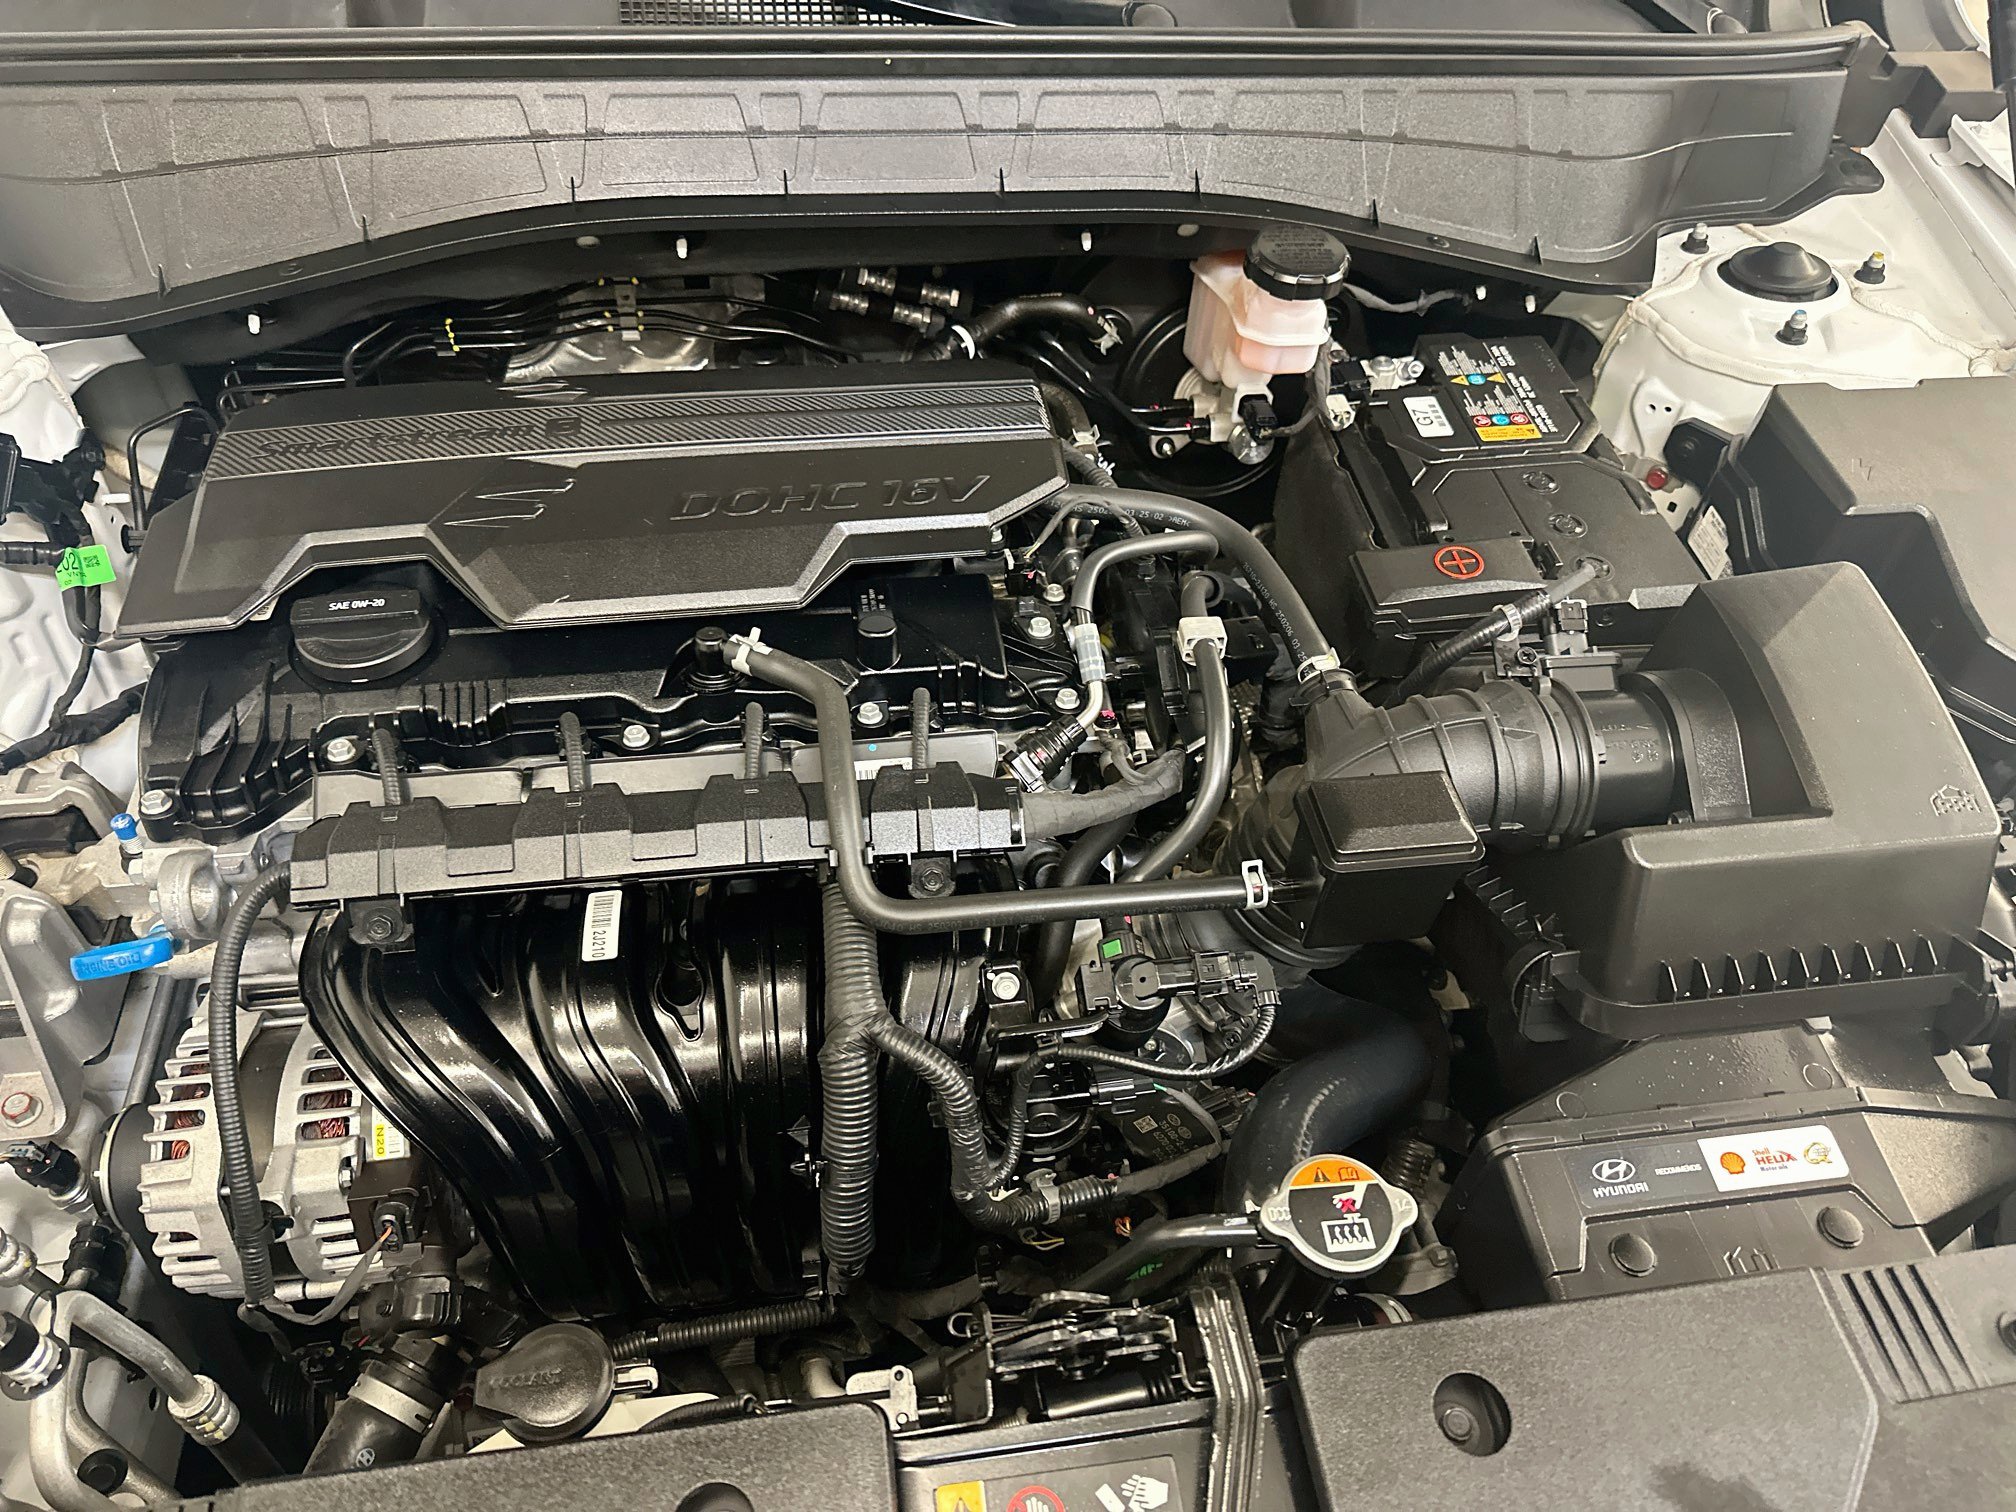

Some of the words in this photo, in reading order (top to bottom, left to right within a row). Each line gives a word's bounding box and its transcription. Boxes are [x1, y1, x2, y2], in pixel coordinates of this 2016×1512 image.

[1411, 409, 1434, 426] G7
[670, 482, 867, 521] DOHC
[882, 474, 991, 507] 16V
[328, 601, 350, 611] SAE
[351, 599, 386, 609] 0W-20
[1275, 610, 1294, 637] 250206
[592, 930, 607, 958] 2J210
[118, 951, 141, 966] OIL
[376, 1126, 385, 1155] N20
[1752, 1148, 1770, 1157] Shell
[1755, 1150, 1798, 1165] HELIX
[1593, 1181, 1649, 1198] HYUNDAI
